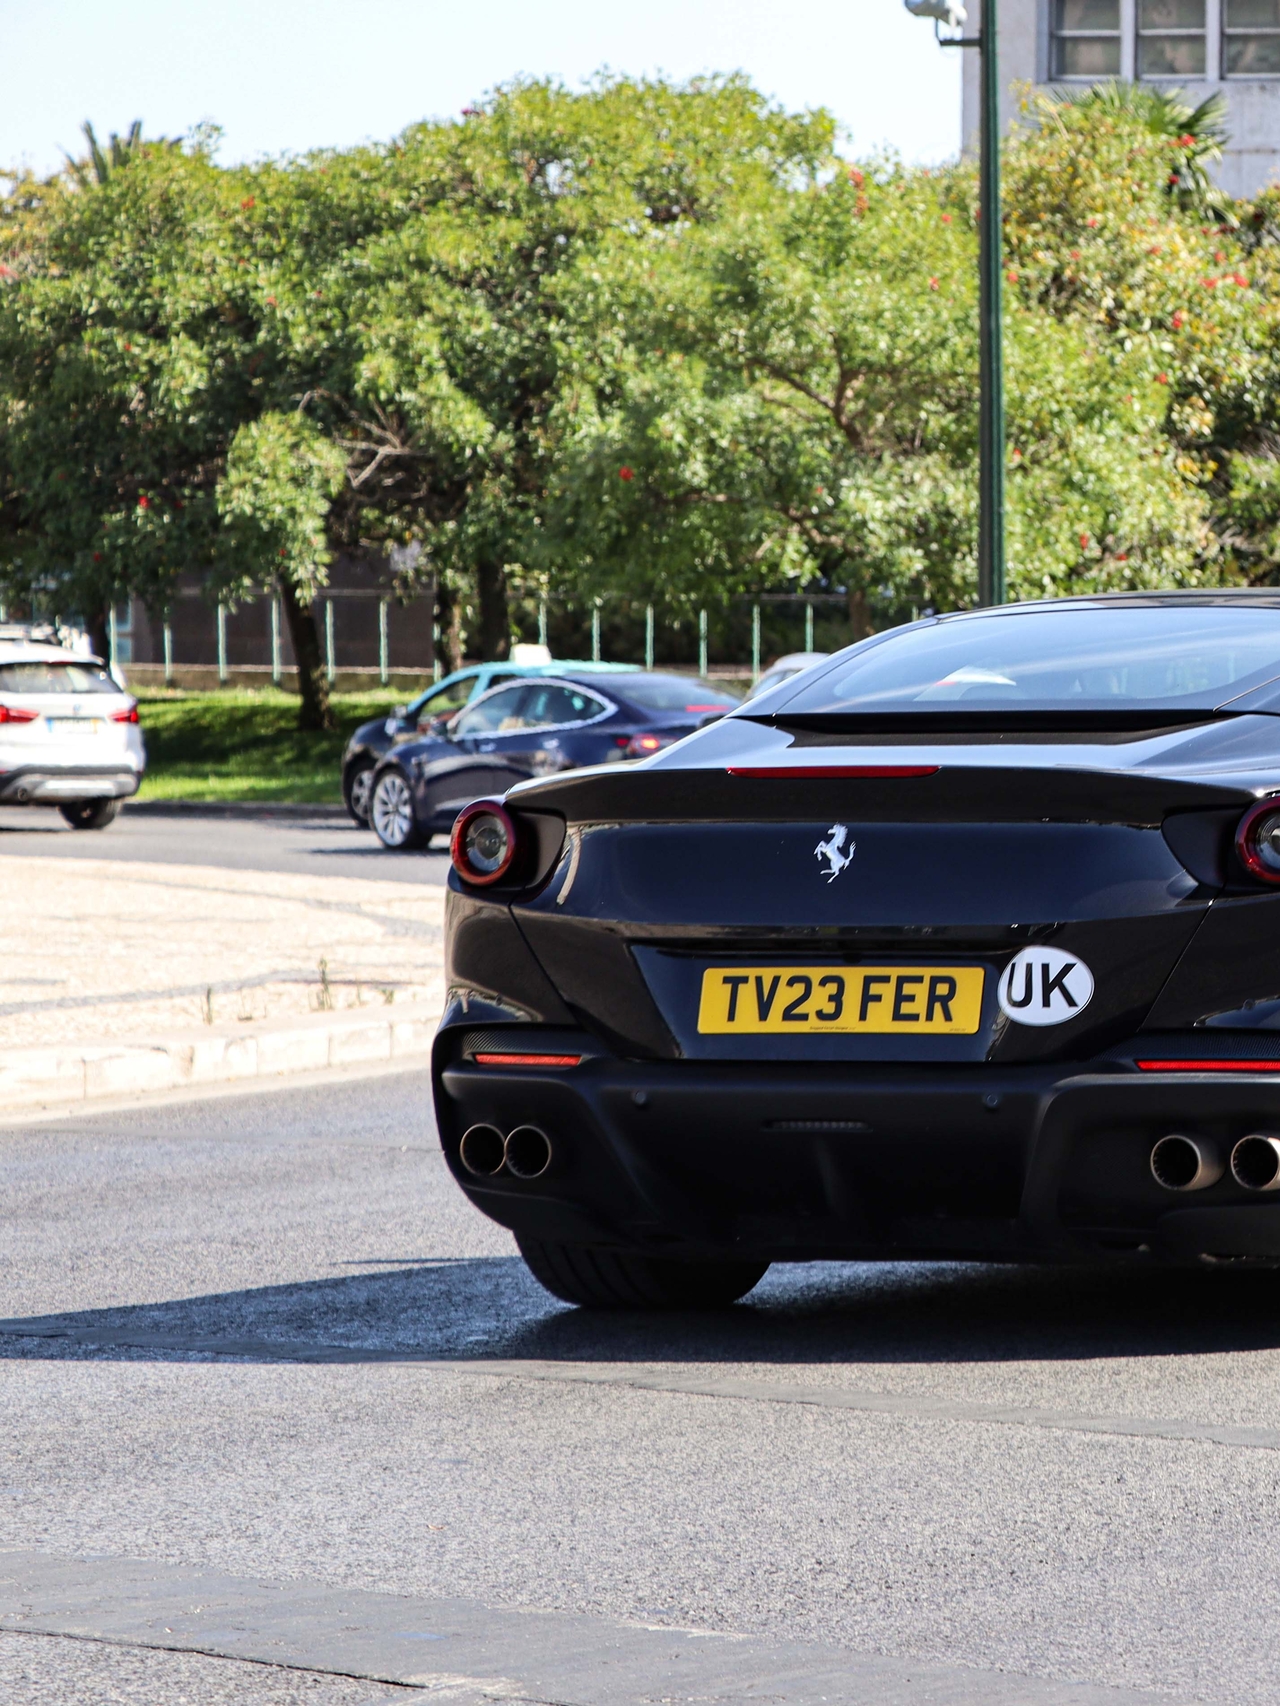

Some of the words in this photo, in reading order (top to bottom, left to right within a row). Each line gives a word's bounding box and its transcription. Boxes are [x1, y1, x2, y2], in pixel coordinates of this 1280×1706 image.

[721, 974, 846, 1022] TV23
[857, 974, 958, 1022] FER
[1007, 962, 1079, 1009] UK
